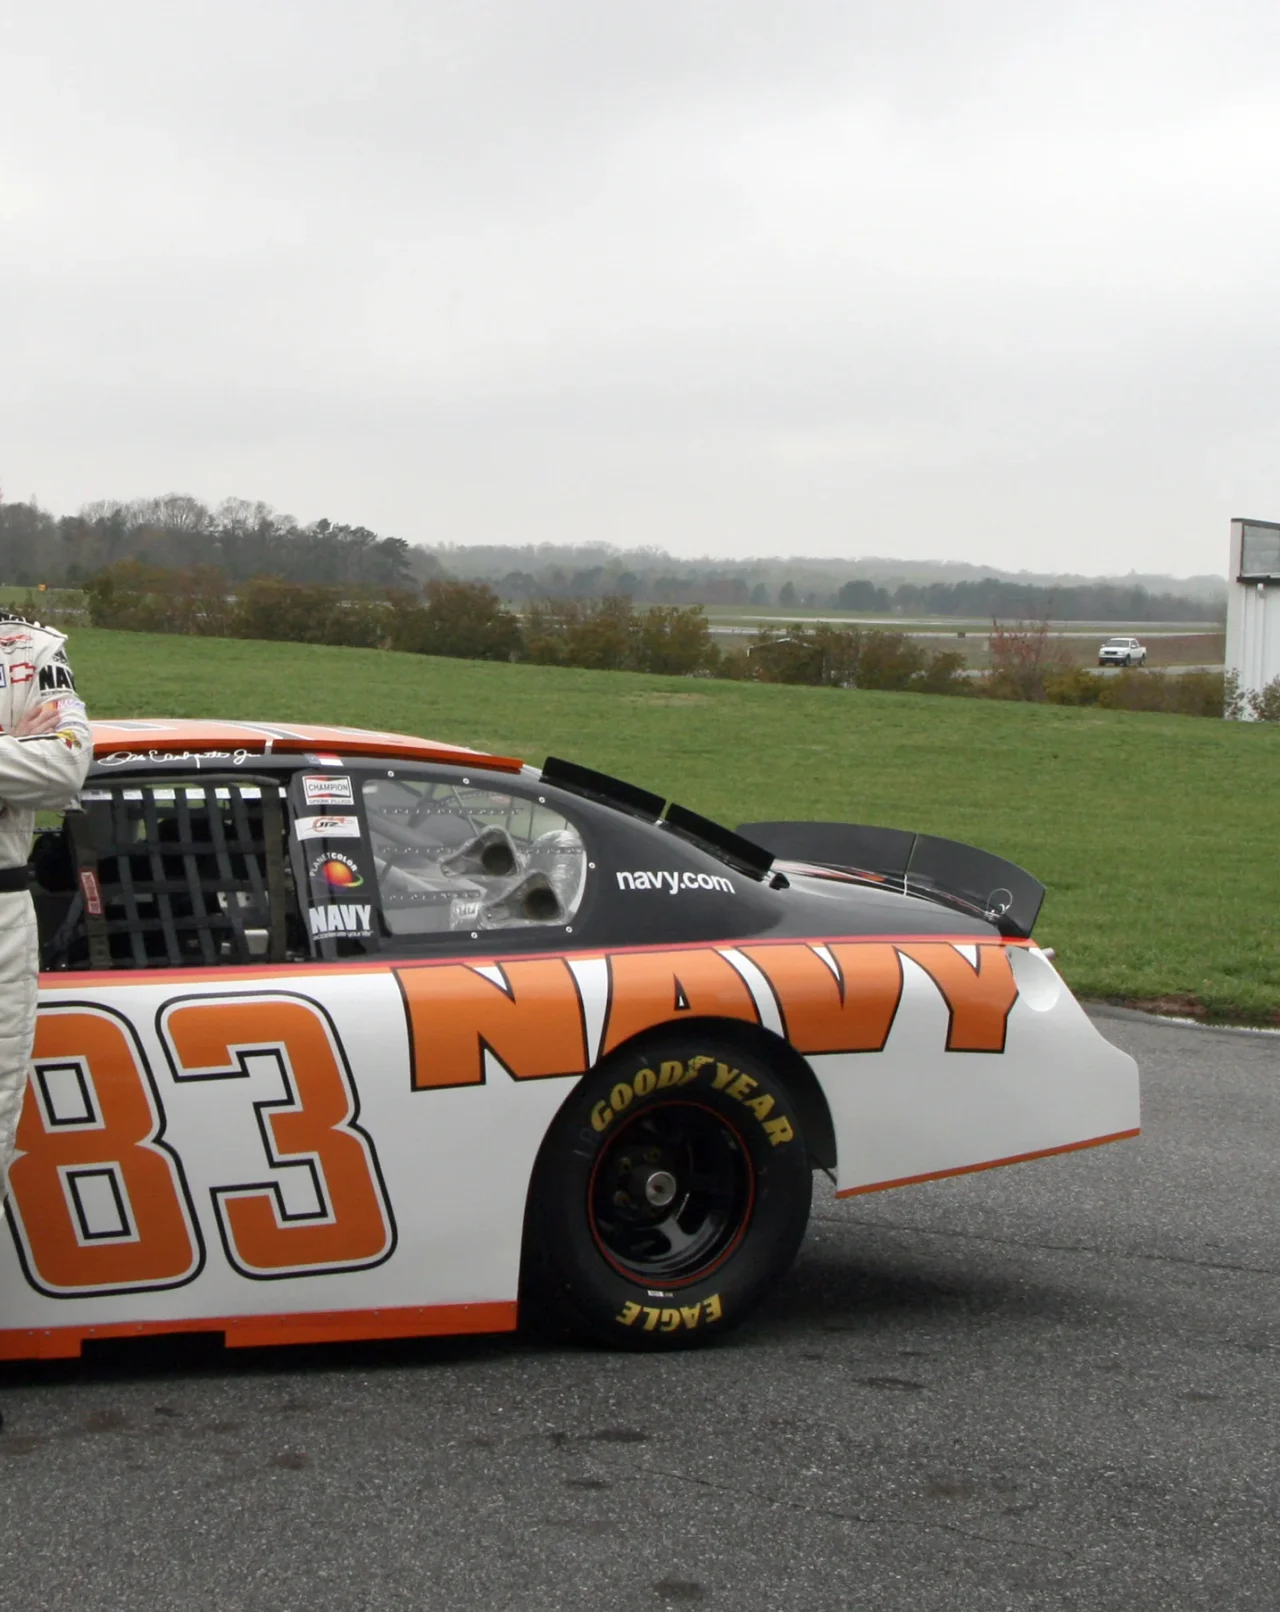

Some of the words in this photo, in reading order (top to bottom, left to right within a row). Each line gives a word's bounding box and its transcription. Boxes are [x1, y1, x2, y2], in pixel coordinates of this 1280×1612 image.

[308, 783, 348, 792] CHAMPION
[616, 871, 736, 894] navy.com
[309, 904, 371, 934] NAVY
[391, 941, 1019, 1092] NAVY
[4, 989, 398, 1299] 83
[616, 1294, 722, 1331] EAGLE
